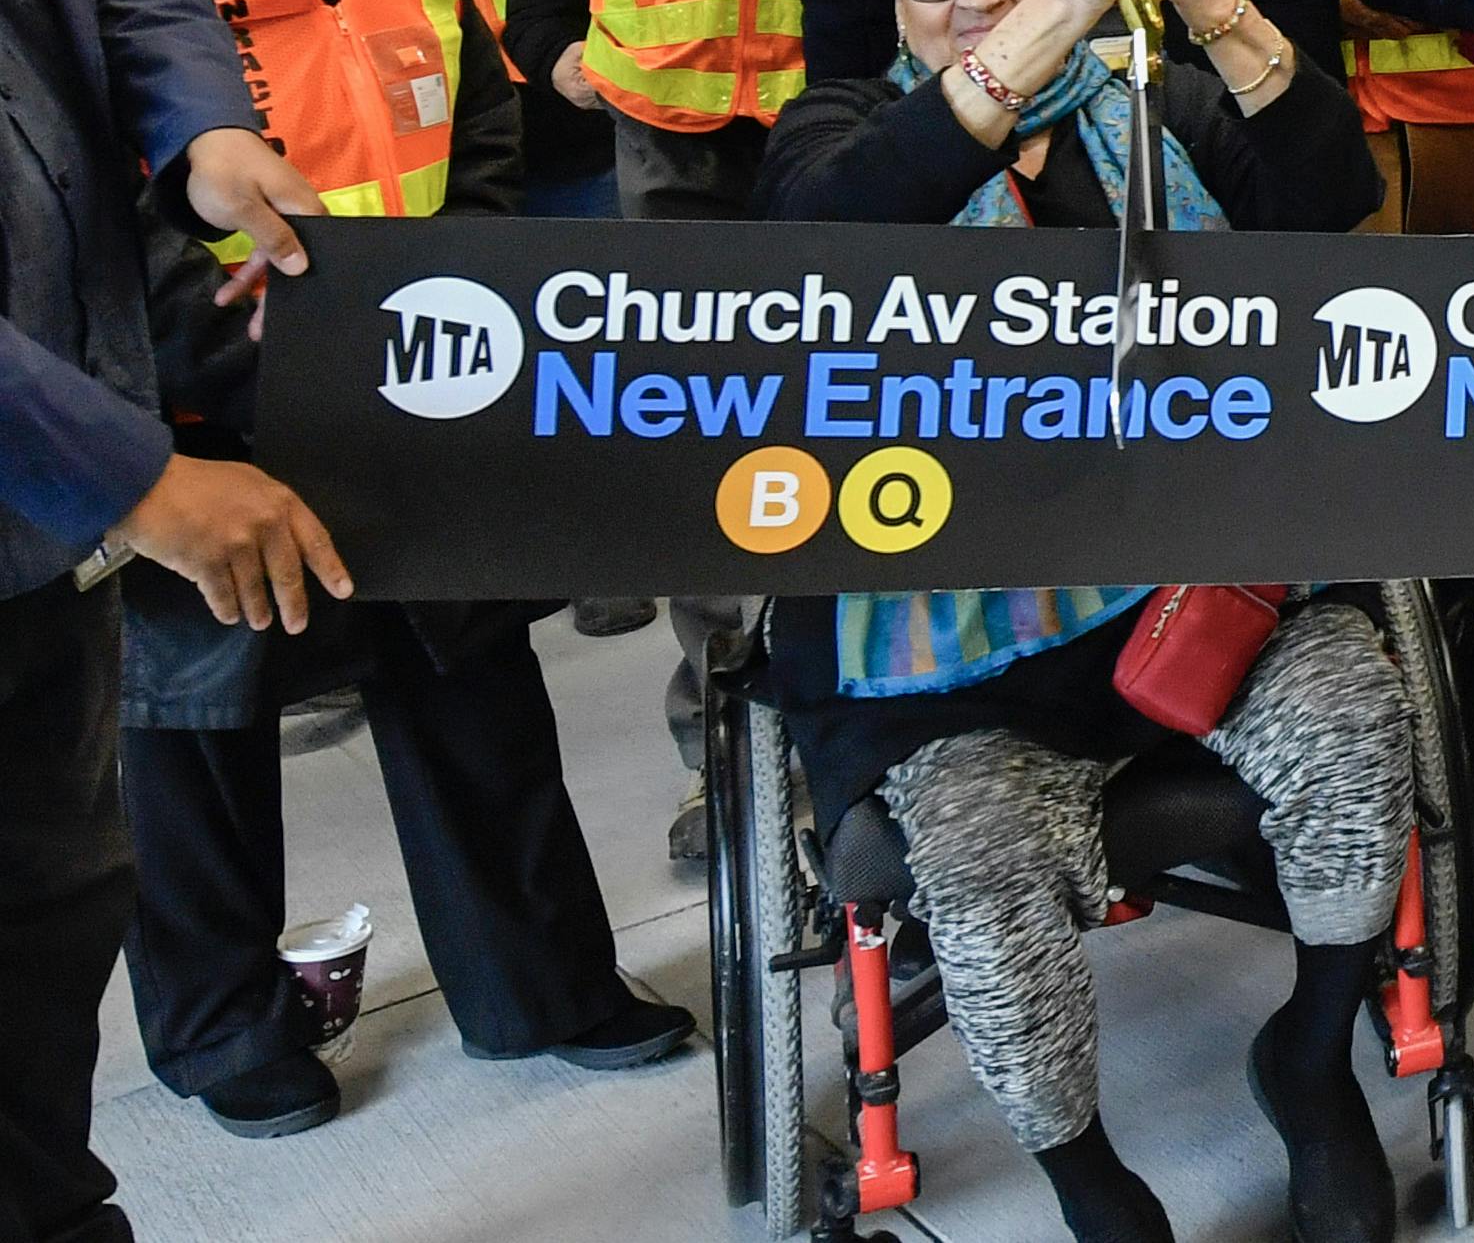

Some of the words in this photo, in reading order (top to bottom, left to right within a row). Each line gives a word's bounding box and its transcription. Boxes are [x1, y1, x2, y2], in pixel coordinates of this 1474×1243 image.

[536, 271, 852, 343] Church
[866, 276, 977, 344] Av
[990, 276, 1278, 346] Station
[377, 314, 494, 388] MTA
[1311, 322, 1413, 395] MTA
[534, 351, 783, 438] New
[804, 352, 1272, 440] Entrance
[750, 471, 800, 527] B
[869, 472, 924, 528] Q
